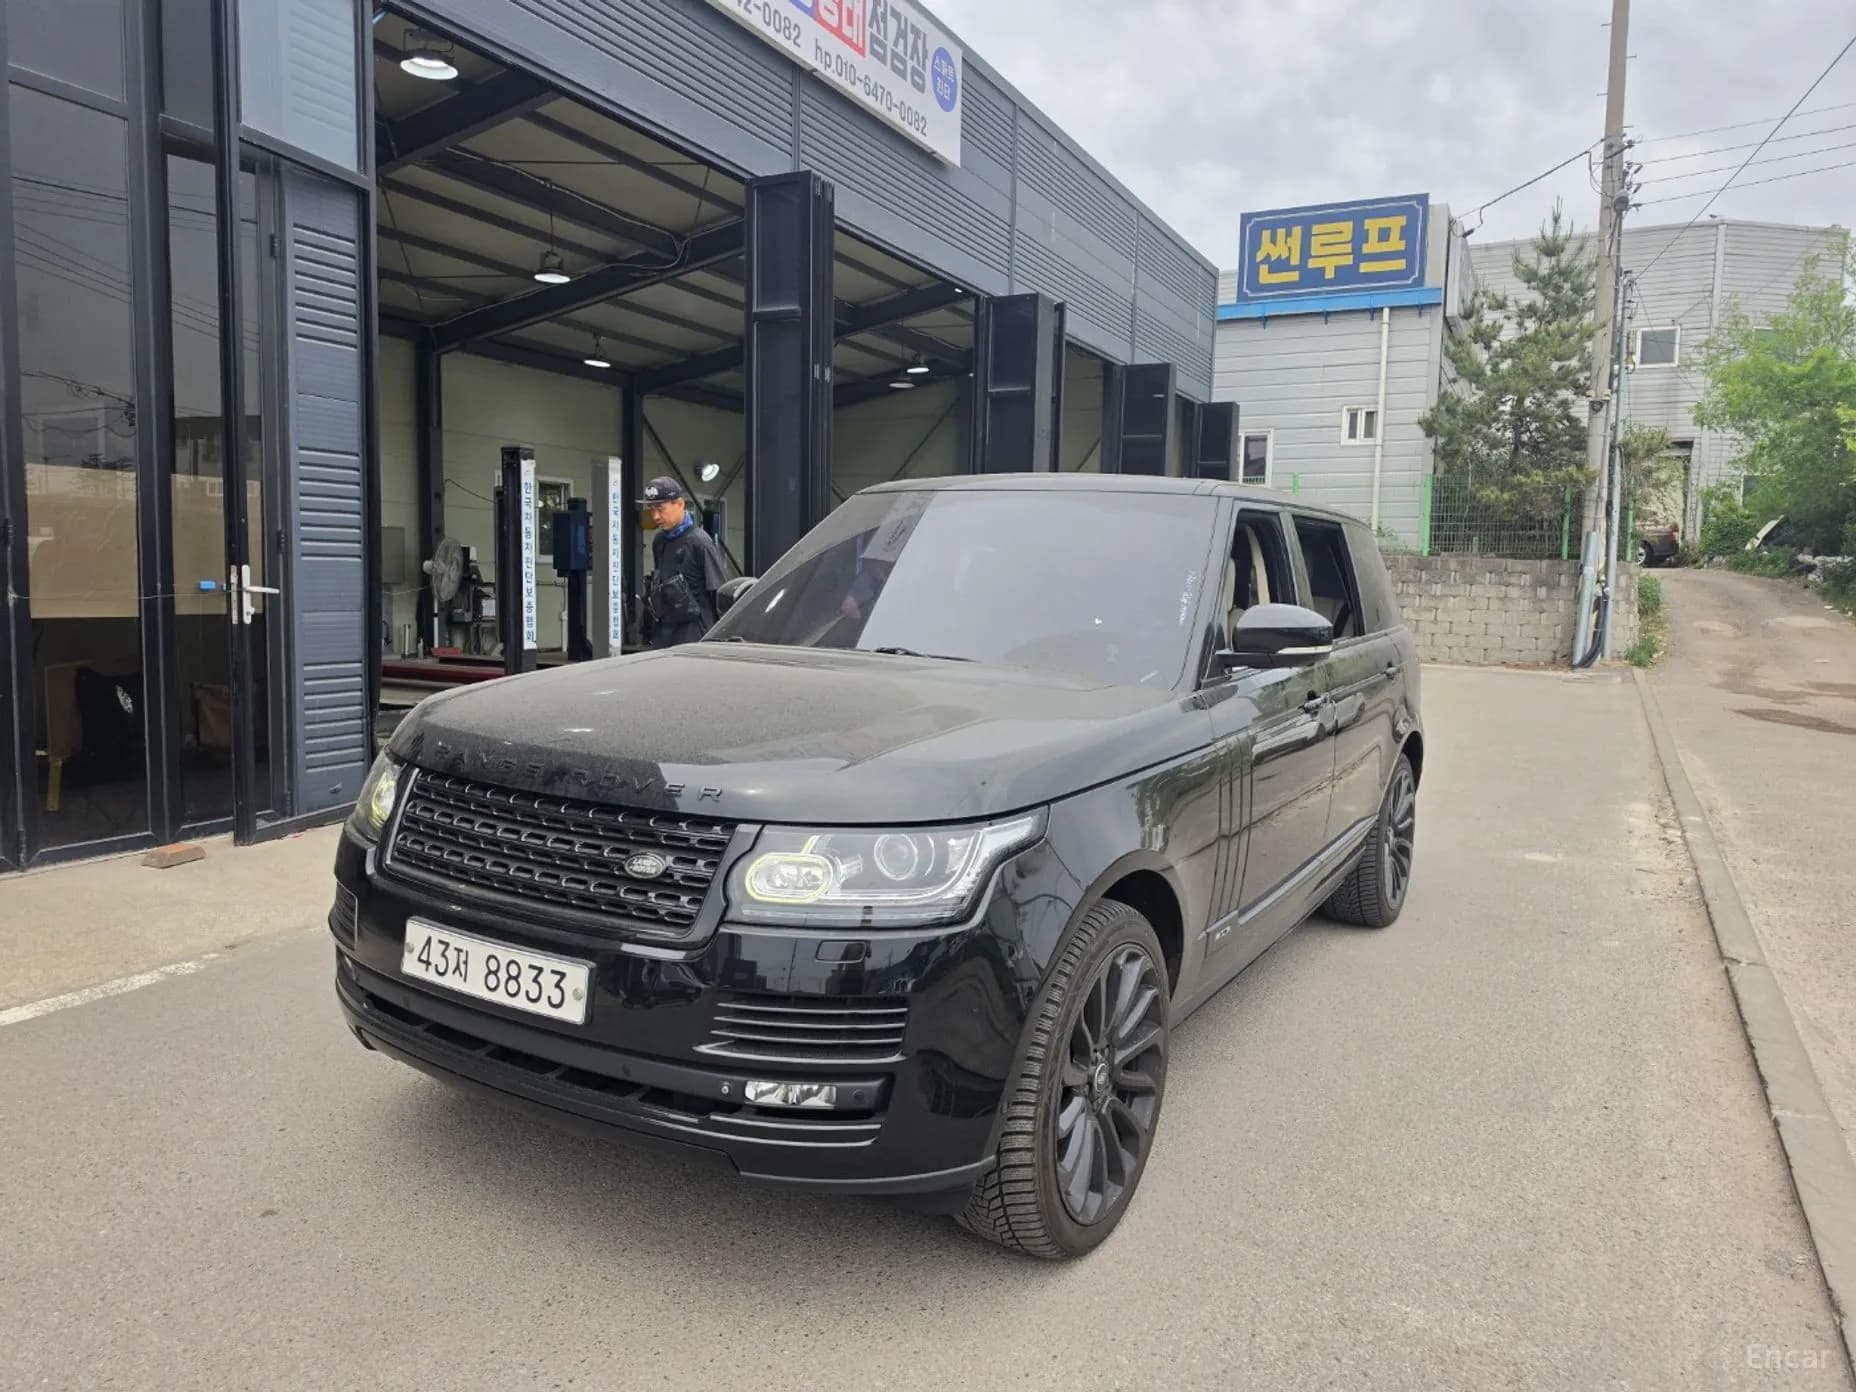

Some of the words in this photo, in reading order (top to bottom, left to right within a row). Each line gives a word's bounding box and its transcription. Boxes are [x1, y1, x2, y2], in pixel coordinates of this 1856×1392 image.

[735, 0, 801, 49] 2-0082
[814, 38, 928, 138] hp.010-6470-0082
[868, 0, 928, 95] 점검장
[1256, 215, 1407, 284] 썬루프
[569, 767, 723, 803] ROVER
[417, 935, 469, 983] 43저
[484, 954, 567, 1010] 8833
